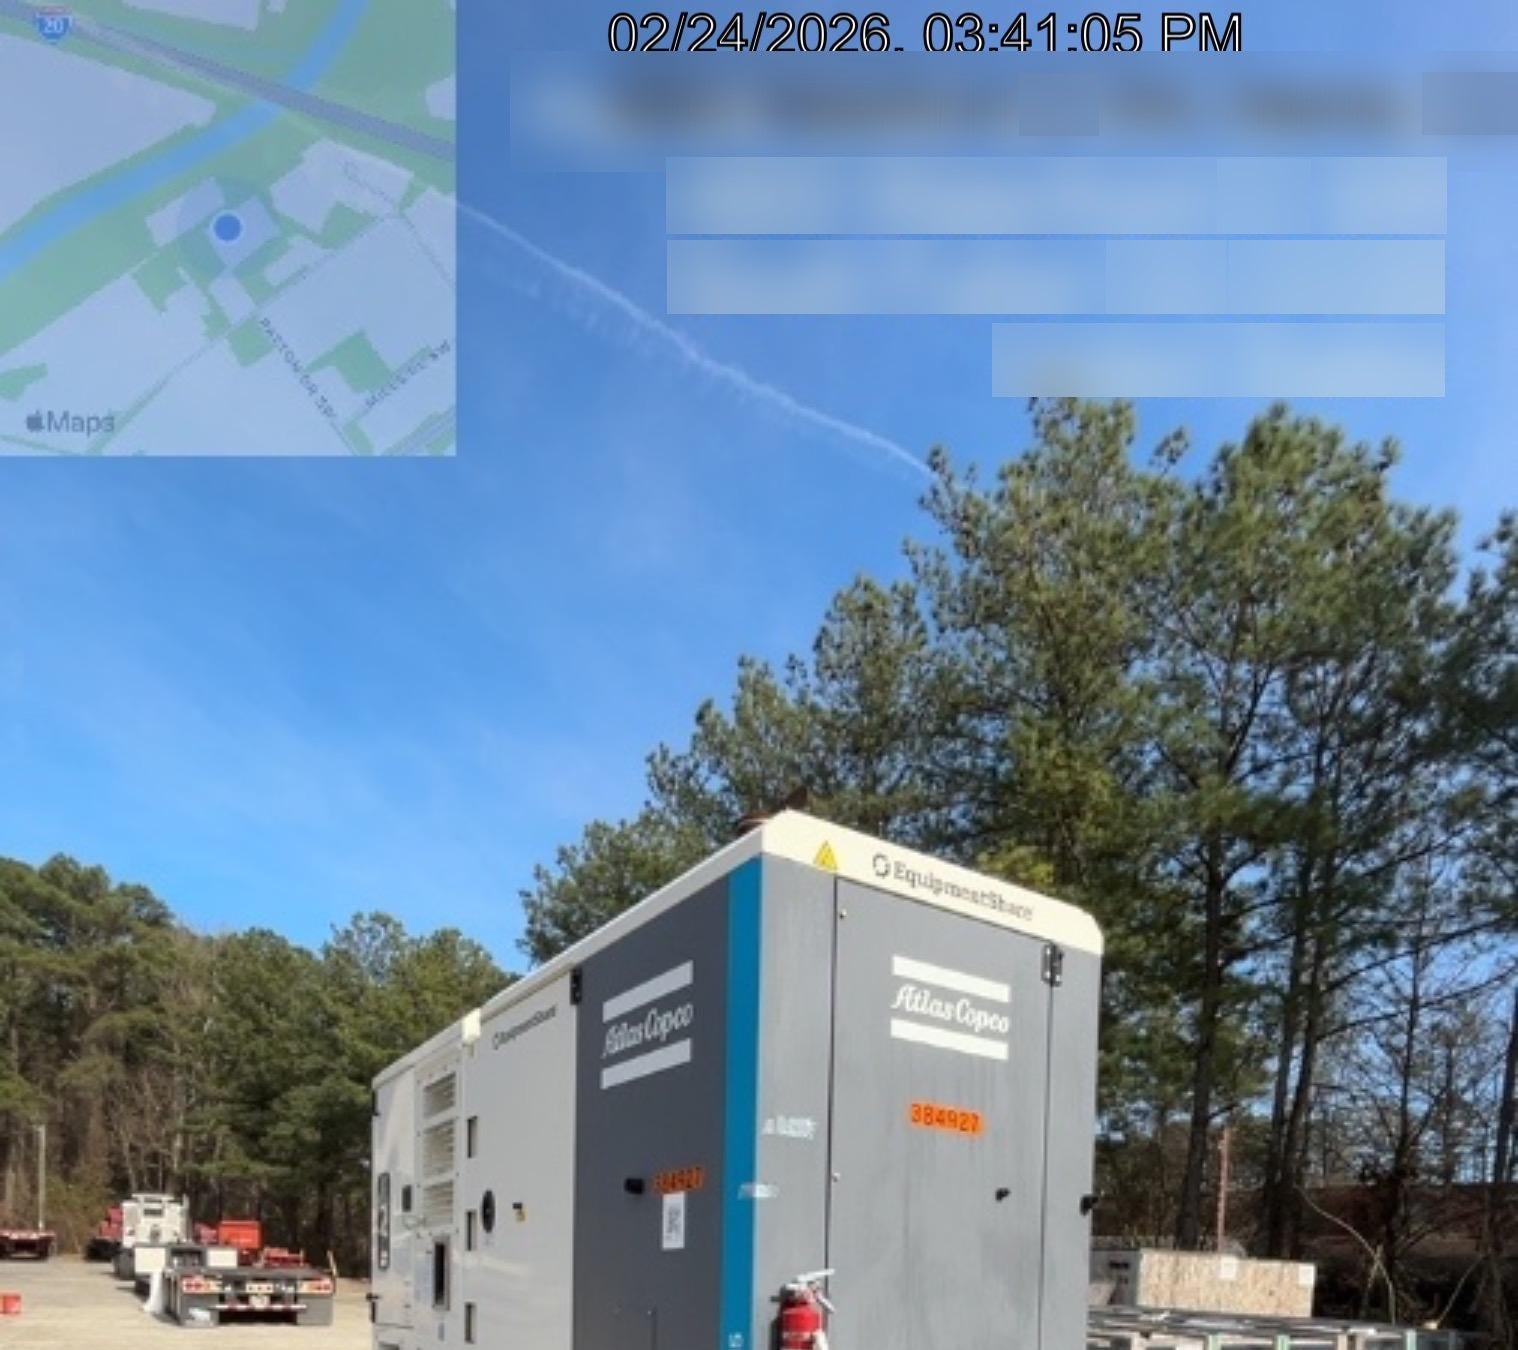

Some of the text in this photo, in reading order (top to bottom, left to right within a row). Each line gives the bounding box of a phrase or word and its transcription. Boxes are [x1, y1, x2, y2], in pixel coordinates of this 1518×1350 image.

[893, 860, 1034, 922] EquipmentShare
[601, 1003, 694, 1059] Atlas Copco
[890, 984, 1009, 1033] Atlas Copco
[910, 1103, 980, 1133] 384927
